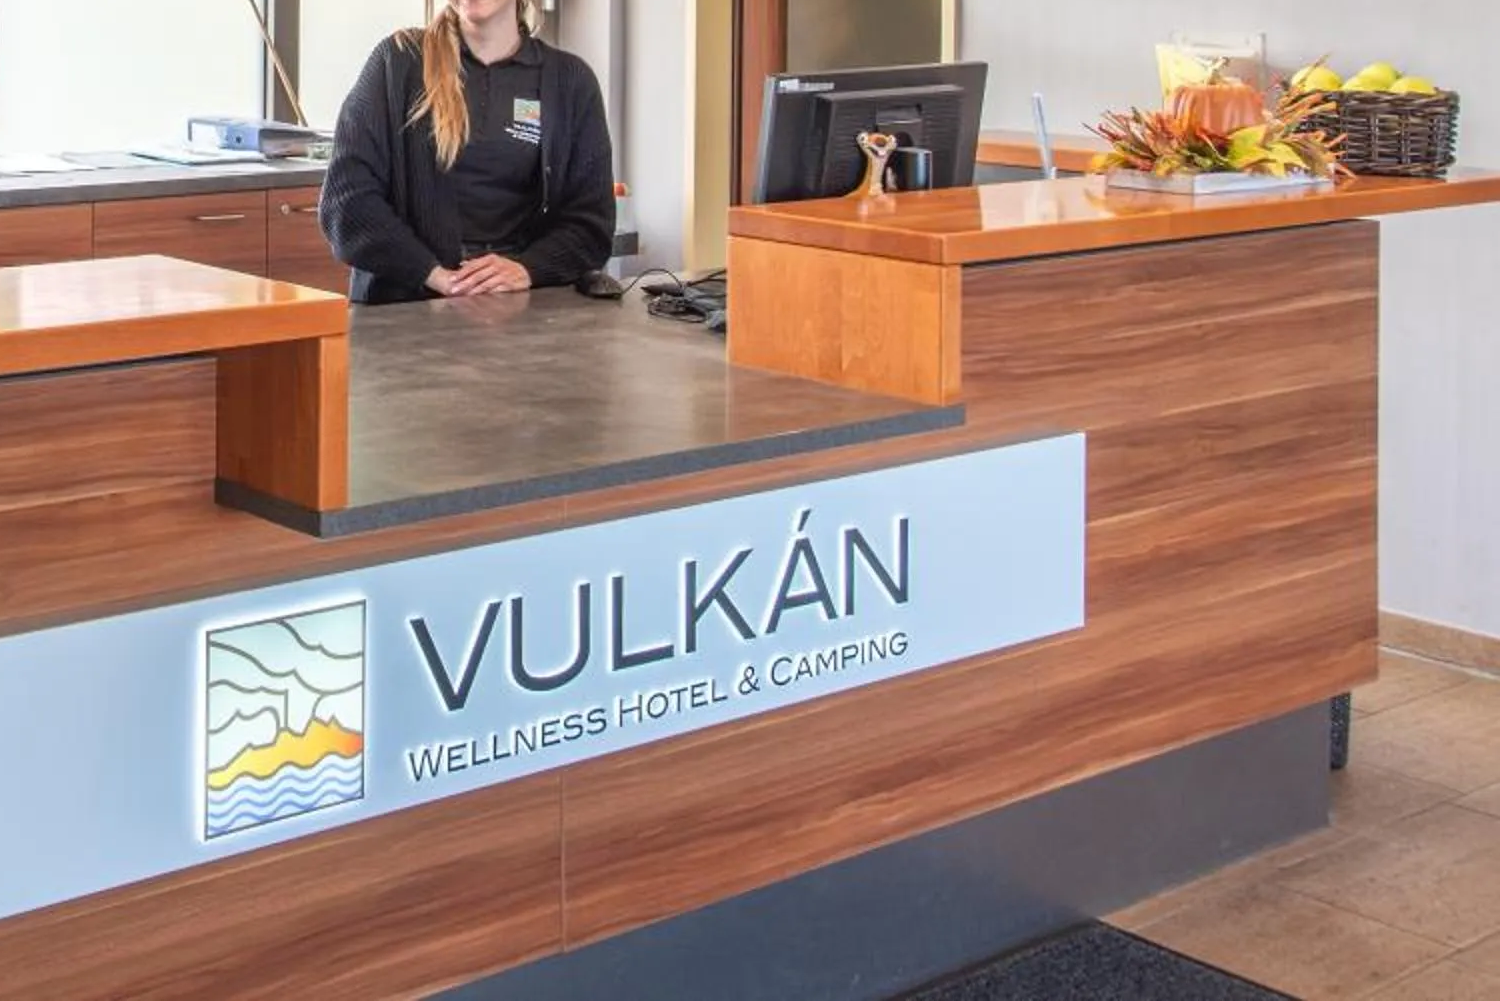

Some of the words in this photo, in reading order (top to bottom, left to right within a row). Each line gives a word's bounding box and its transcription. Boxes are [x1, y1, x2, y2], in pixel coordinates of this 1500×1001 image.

[409, 509, 910, 712] VULKÁN
[408, 707, 608, 783] WELLNESS
[617, 681, 729, 730] HOTEL
[737, 665, 761, 696] &
[769, 631, 910, 687] CAMPING
